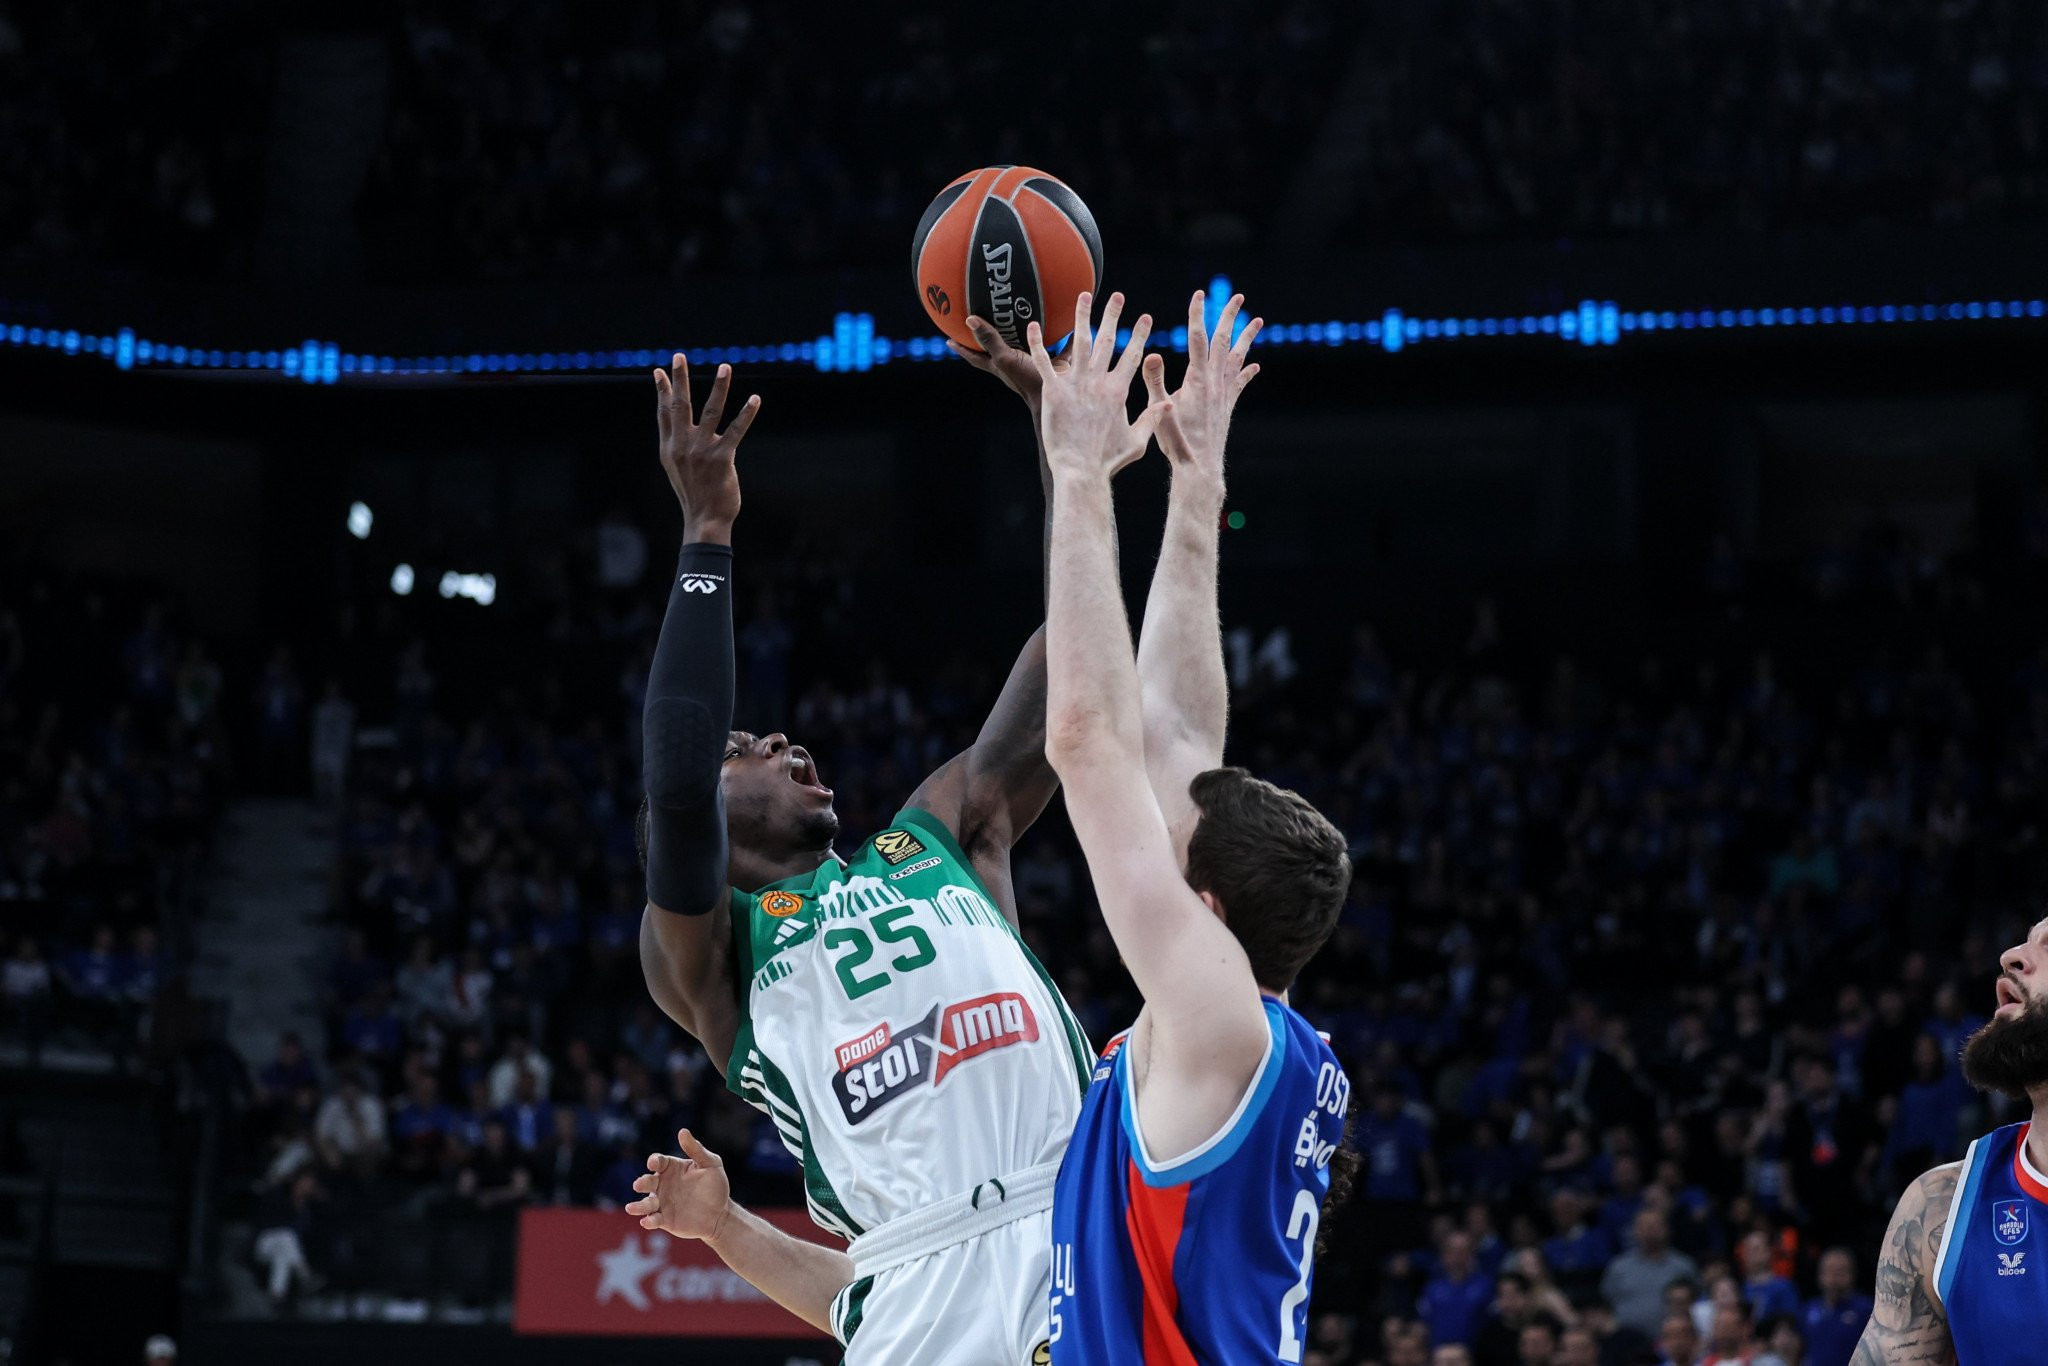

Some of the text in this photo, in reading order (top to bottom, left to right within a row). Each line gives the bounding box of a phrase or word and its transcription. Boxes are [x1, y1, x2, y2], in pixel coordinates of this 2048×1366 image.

[982, 242, 1025, 350] SPALDIN
[824, 905, 937, 1000] 25
[840, 1028, 886, 1068] pame
[1999, 1221, 2024, 1231] ANADOLU
[2003, 1227, 2021, 1236] EFES
